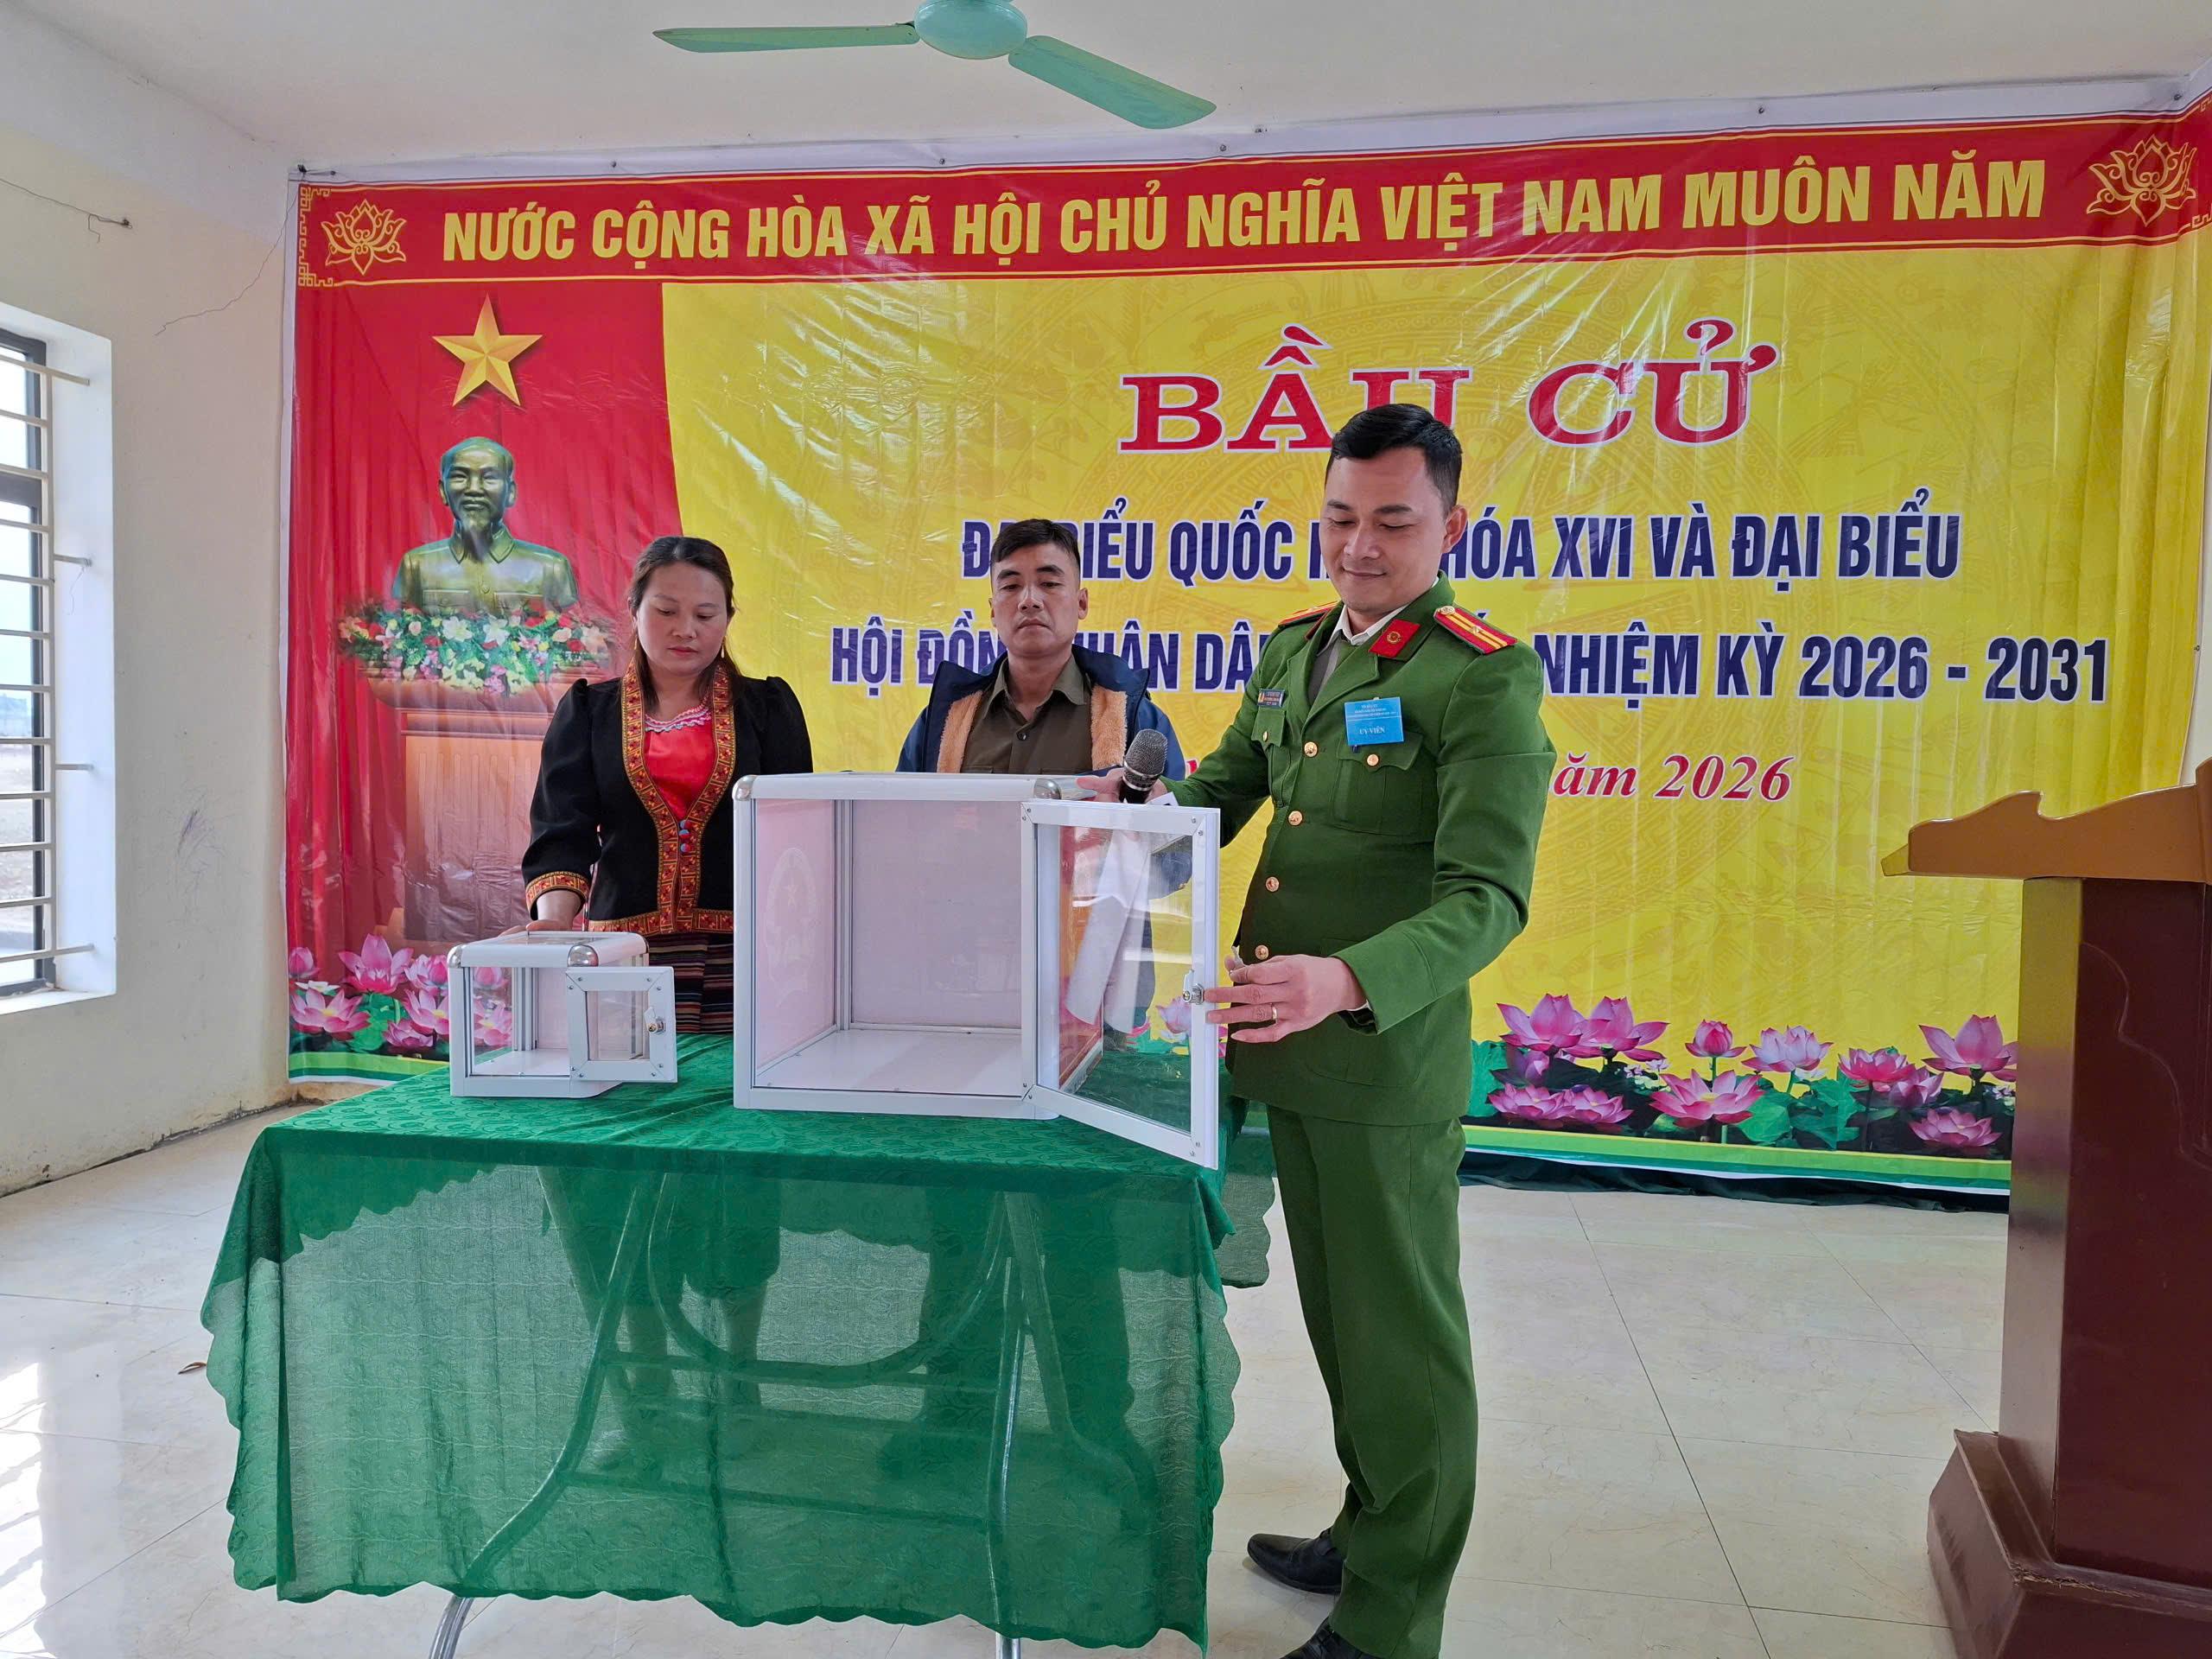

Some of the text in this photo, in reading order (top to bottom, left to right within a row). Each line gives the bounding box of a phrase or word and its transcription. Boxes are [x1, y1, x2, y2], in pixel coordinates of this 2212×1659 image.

[443, 149, 2046, 270] NƯỚC CỘNG HÒA XÃ HỘI CHỦ NGHĨA VIỆT NAM MUÔN NĂM
[1529, 317, 1780, 447] CỬ
[1054, 497, 1154, 581] IỂU
[1170, 499, 1294, 588] QUỐC
[1550, 515, 1632, 579] XVI
[1649, 501, 1720, 579] VÀ
[1731, 515, 1820, 593] ĐẠI
[1837, 487, 1961, 580] BIỂU
[831, 615, 902, 696] HỘI
[1533, 621, 1700, 709] NHIỆM
[1717, 621, 1784, 697] KỲ
[1800, 636, 1929, 701] 2026
[1946, 666, 1967, 679] -
[1986, 638, 2109, 702] 2031
[1552, 752, 1796, 802] ăm 2026
